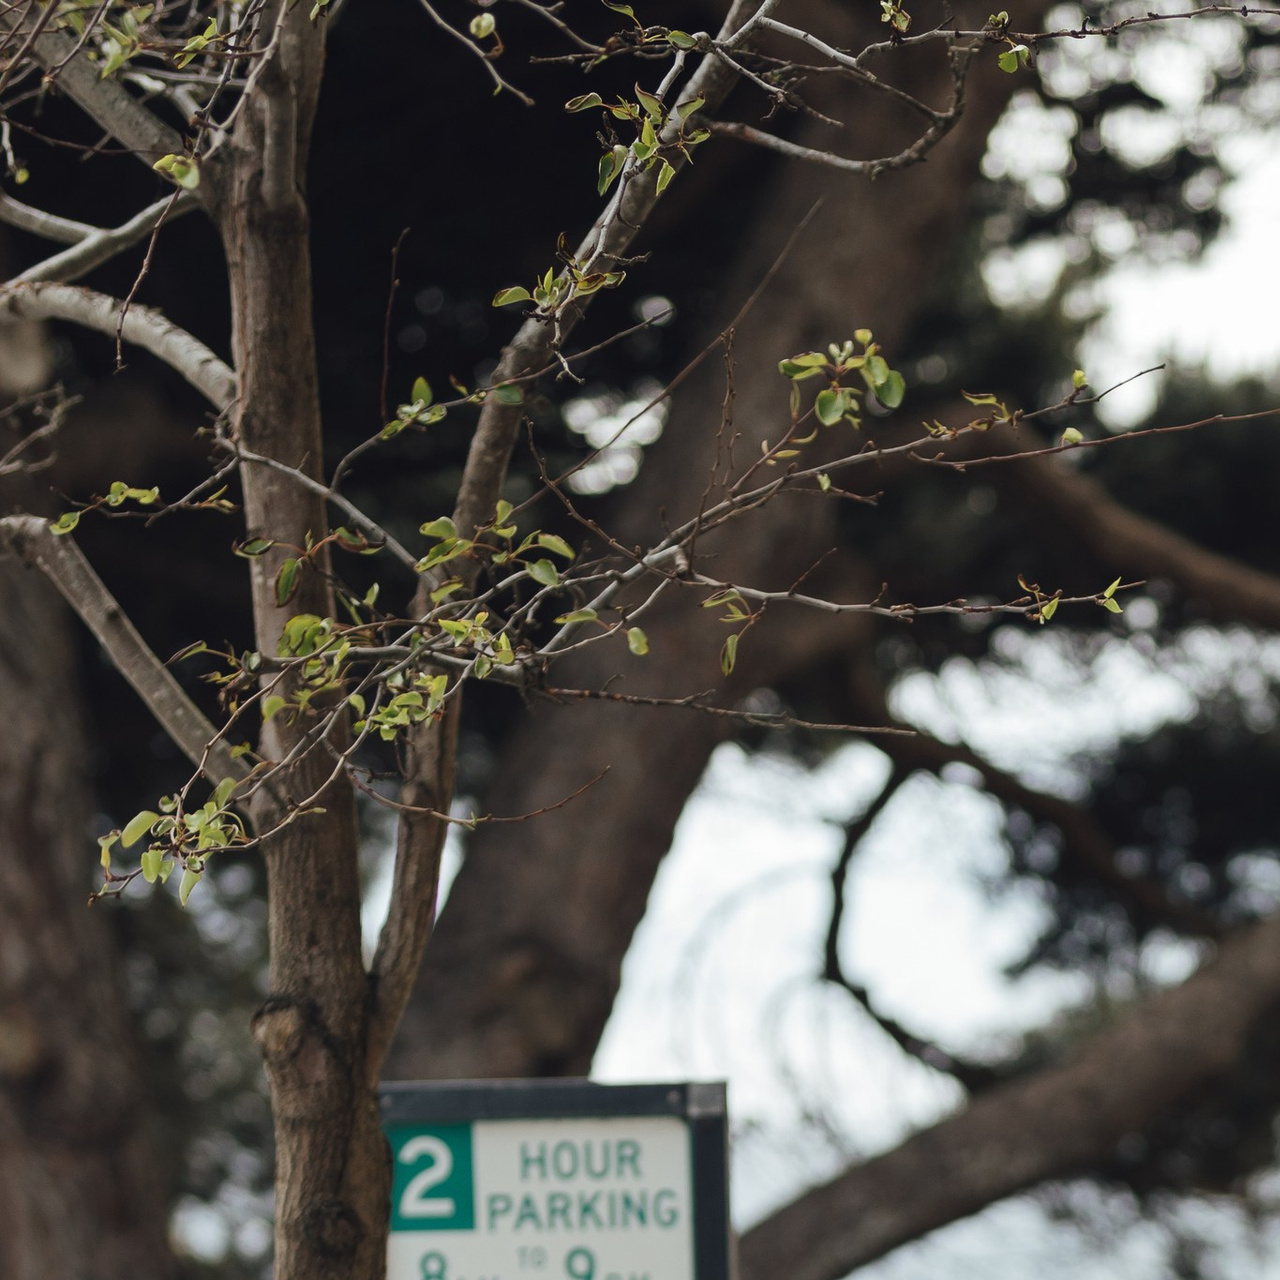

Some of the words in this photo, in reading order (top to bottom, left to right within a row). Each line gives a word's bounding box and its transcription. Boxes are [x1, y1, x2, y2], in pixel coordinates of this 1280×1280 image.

[397, 1134, 457, 1219] 2
[518, 1138, 643, 1183] HOUR
[486, 1188, 681, 1233] PARKING
